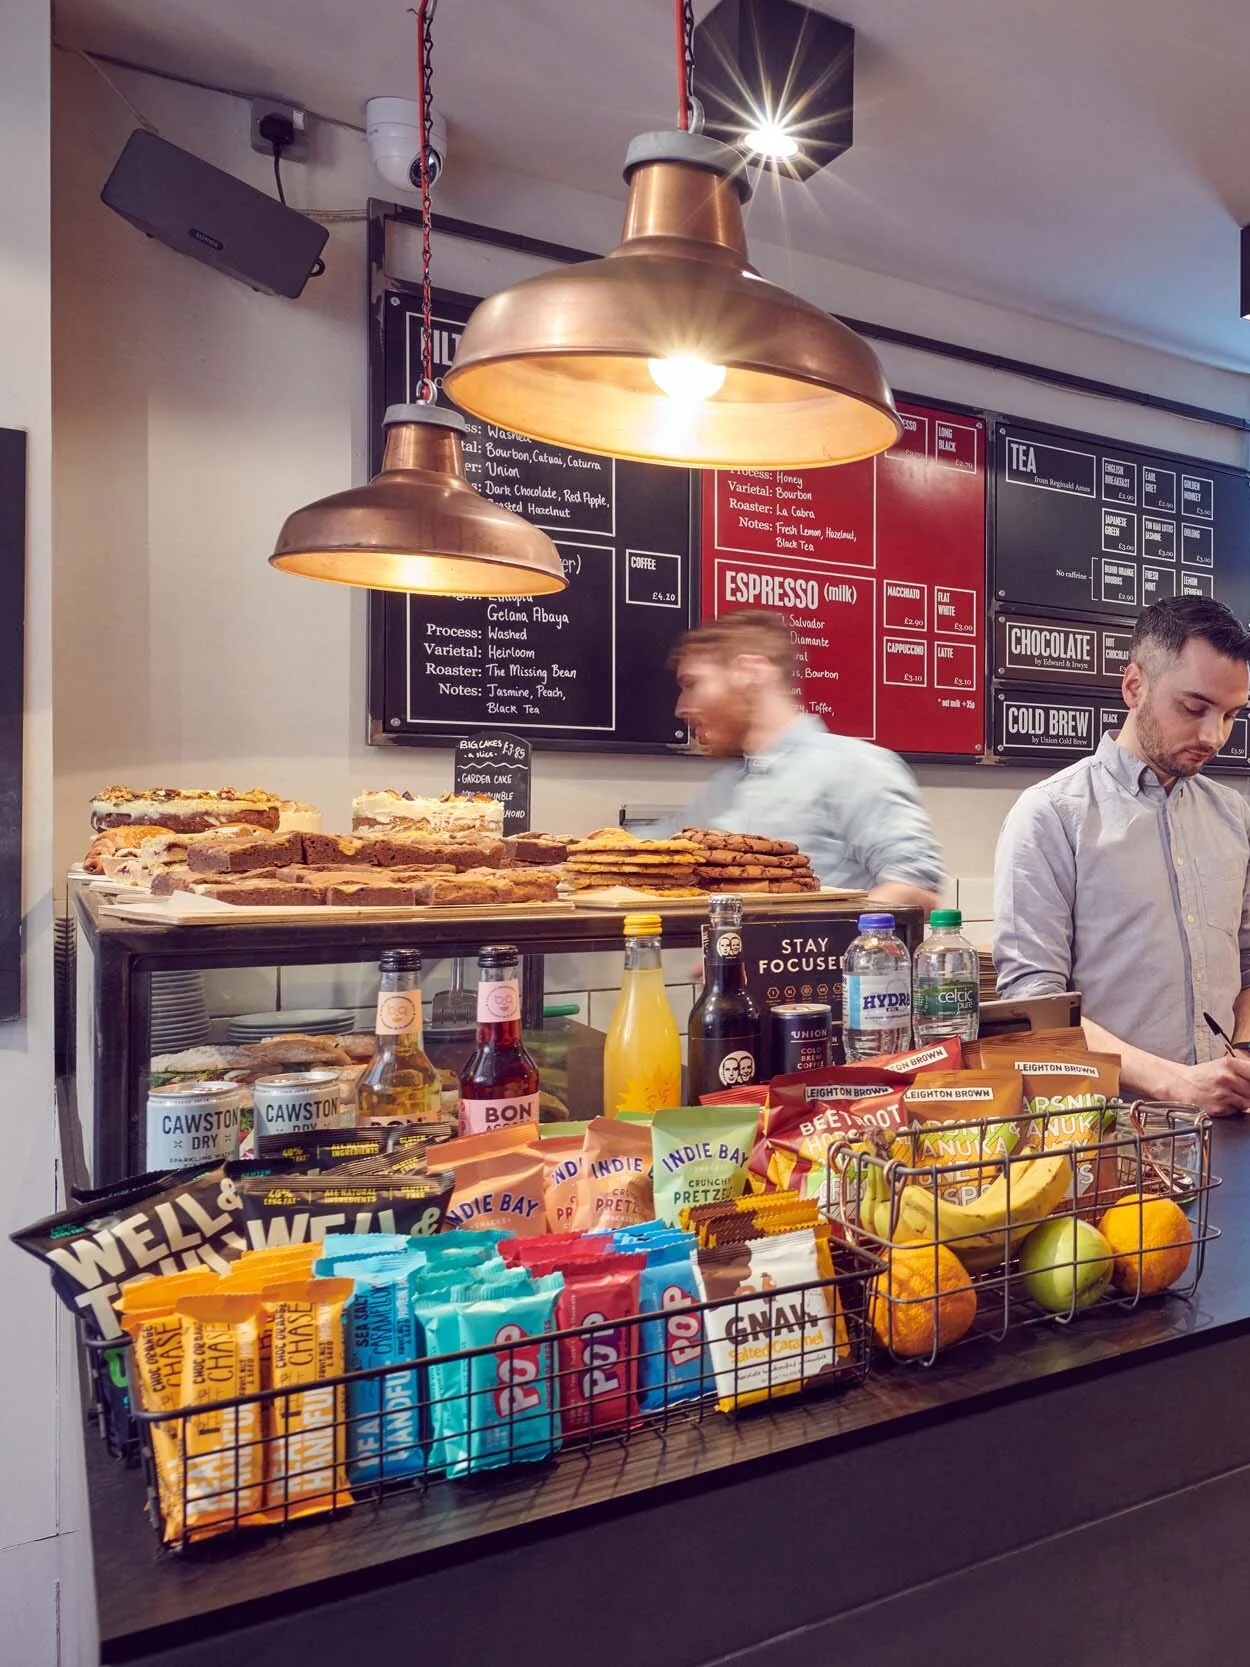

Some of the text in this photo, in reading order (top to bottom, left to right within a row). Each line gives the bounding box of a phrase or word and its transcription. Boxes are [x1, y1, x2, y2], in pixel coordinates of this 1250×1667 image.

[938, 425, 952, 439] LONG
[938, 439, 956, 453] BLACK
[1010, 442, 1038, 474] TEA
[485, 461, 520, 478] Union
[776, 472, 803, 489] Honey
[484, 480, 511, 496] Dark
[514, 485, 561, 502] Chocolate,
[563, 489, 581, 503] Red
[728, 480, 812, 500] Varietal: Bourbon
[528, 502, 571, 518] Hazelnut
[729, 498, 773, 514] Roaster:
[776, 504, 788, 516] La
[738, 516, 773, 531] Notes:
[776, 522, 798, 536] Fresh
[776, 538, 815, 552] Black Tea
[630, 556, 656, 570] COFFEE
[1056, 568, 1064, 578] No
[652, 592, 676, 602] £4.20
[725, 570, 858, 610] ESPRESSO (milk)
[938, 592, 951, 603] FLAT
[790, 614, 826, 629] Salvador
[904, 616, 924, 626] £2.90
[954, 622, 974, 632] £3.00
[426, 623, 528, 640] Process: Washed
[790, 630, 830, 648] Diamante
[424, 642, 535, 659] Varietal: Heirloom
[1011, 628, 1091, 661] CHOCOLATE
[1105, 638, 1115, 648] HOT
[938, 647, 954, 659] LATTE
[1034, 657, 1042, 666] by
[1105, 650, 1129, 660] CHOCOLAT
[425, 662, 577, 685] Roaster: The Missing Bean
[438, 682, 566, 701] Notes: Jasmine, Peach,
[487, 702, 540, 715] Black Tea
[1008, 706, 1089, 737] COLD BREW
[1102, 713, 1118, 724] BLACK
[460, 740, 478, 750] BIG
[479, 740, 502, 749] CAKES
[1032, 736, 1040, 744] by
[1040, 736, 1058, 744] Union
[494, 774, 513, 784] CAKE
[781, 937, 829, 954] STAY
[758, 955, 844, 975] FOCUSE
[790, 1029, 828, 1040] UNION
[910, 1048, 944, 1070] BROWN
[1016, 1062, 1097, 1076] LEIGHTON BROWN
[806, 1086, 890, 1098] LEIGHTON BROWN
[905, 1088, 990, 1100] LEIGHTON BROWN
[266, 1096, 339, 1122] CAWSTON
[485, 1102, 532, 1123] BON
[162, 1107, 240, 1134] CAWSTON
[192, 1134, 218, 1150] DRY
[661, 1142, 750, 1173] INDIE BAY
[591, 1158, 644, 1180] INDIE
[674, 1186, 733, 1205] PRETZE
[500, 1193, 540, 1218] BAY
[46, 1178, 244, 1290] WELL &
[354, 1294, 370, 1348] SEA SALT
[662, 1286, 702, 1366] POP
[724, 1301, 819, 1346] GNAW
[288, 1302, 314, 1366] CHASE
[276, 1343, 288, 1369] CHOC
[580, 1312, 620, 1399] POP
[148, 1366, 166, 1393] CHOC
[192, 1358, 206, 1385] CHOC
[496, 1325, 539, 1418] POP
[384, 1360, 414, 1462] HANDFU
